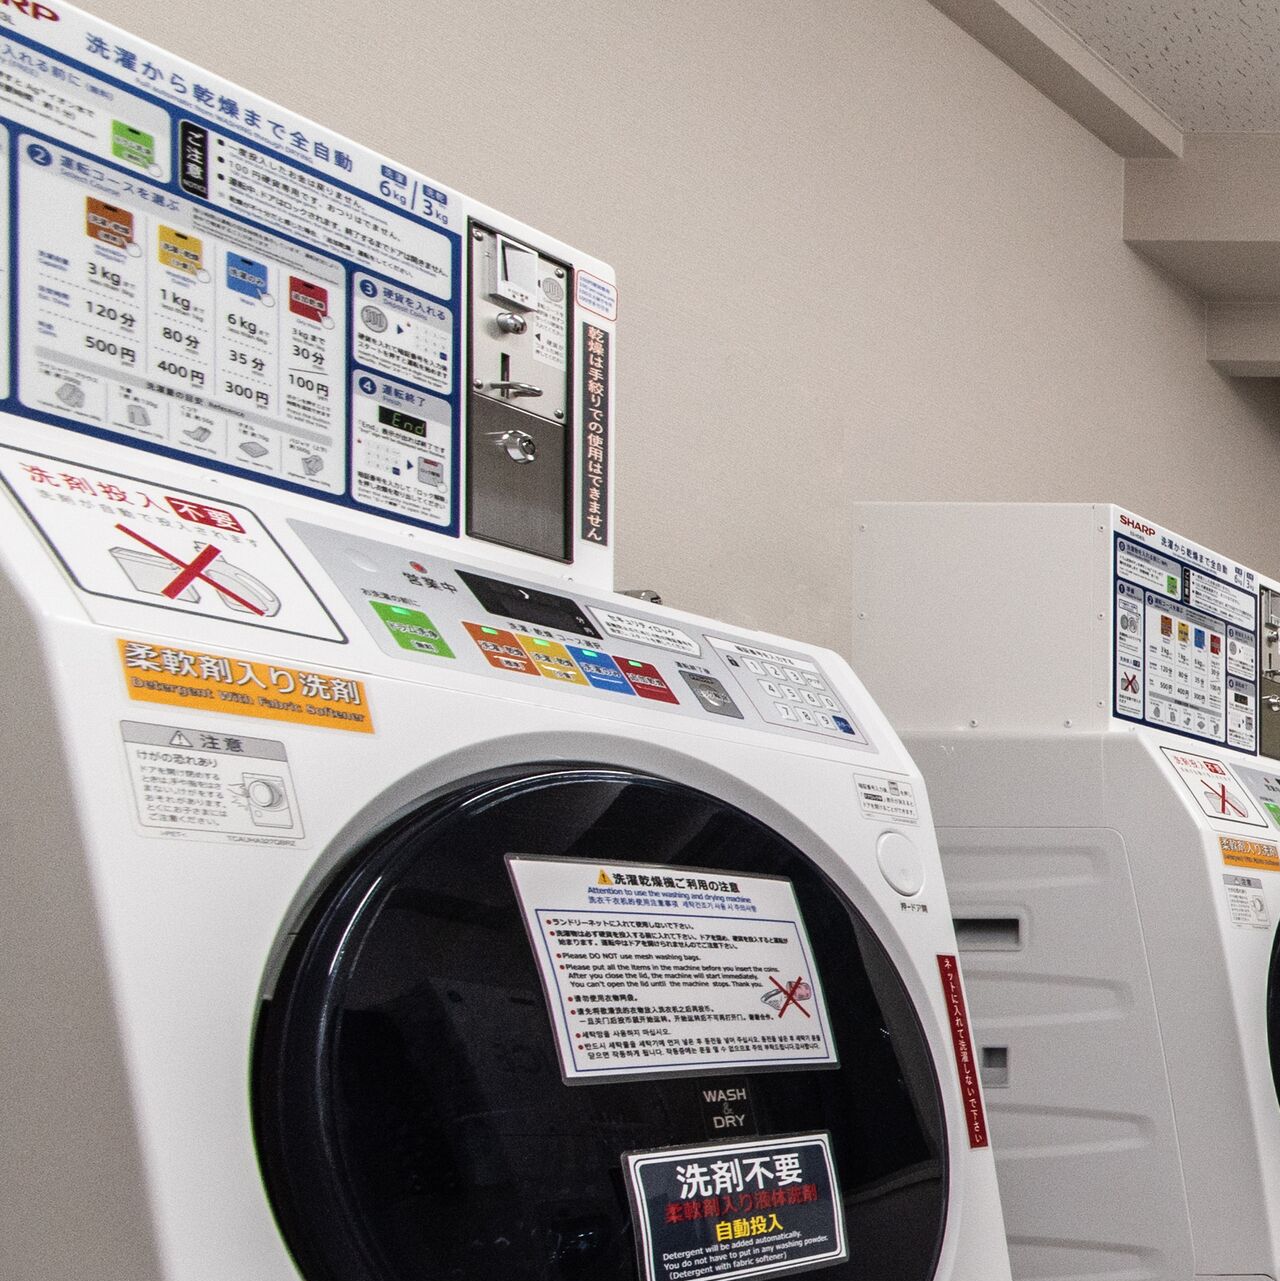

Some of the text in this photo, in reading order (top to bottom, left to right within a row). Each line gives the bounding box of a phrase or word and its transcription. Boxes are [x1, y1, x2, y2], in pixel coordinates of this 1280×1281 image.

[85, 32, 354, 173] 洗濯から乾燥まで全自動
[382, 286, 447, 322] 硬貨を入れる
[1119, 514, 1156, 536] SHARP
[126, 641, 362, 706] 柔軟剤入り洗剤
[131, 676, 214, 699] Detergent
[199, 733, 246, 753] 注意
[136, 749, 218, 768] けがの恐れあり
[612, 872, 741, 894] 洗濯乾燥機ご利用の注意
[562, 952, 587, 960] Please
[589, 952, 601, 960] DO
[602, 952, 618, 960] NOT
[655, 953, 682, 962] washing
[703, 1088, 747, 1103] WASH
[713, 1114, 746, 1129] DRY
[675, 1152, 803, 1200] 洗剤不要
[715, 1213, 784, 1242] 自動投入
[662, 1247, 704, 1261] Detergent
[705, 1243, 719, 1254] will
[720, 1243, 730, 1252] be
[731, 1238, 754, 1250] added
[664, 1261, 681, 1271] You
[681, 1259, 693, 1268] do
[694, 1256, 708, 1265] not
[709, 1253, 728, 1263] have
[738, 1248, 752, 1259] put
[761, 1244, 775, 1254] any
[775, 1238, 803, 1251] washing
[714, 1262, 733, 1272] with
[733, 1258, 754, 1269] fabric
